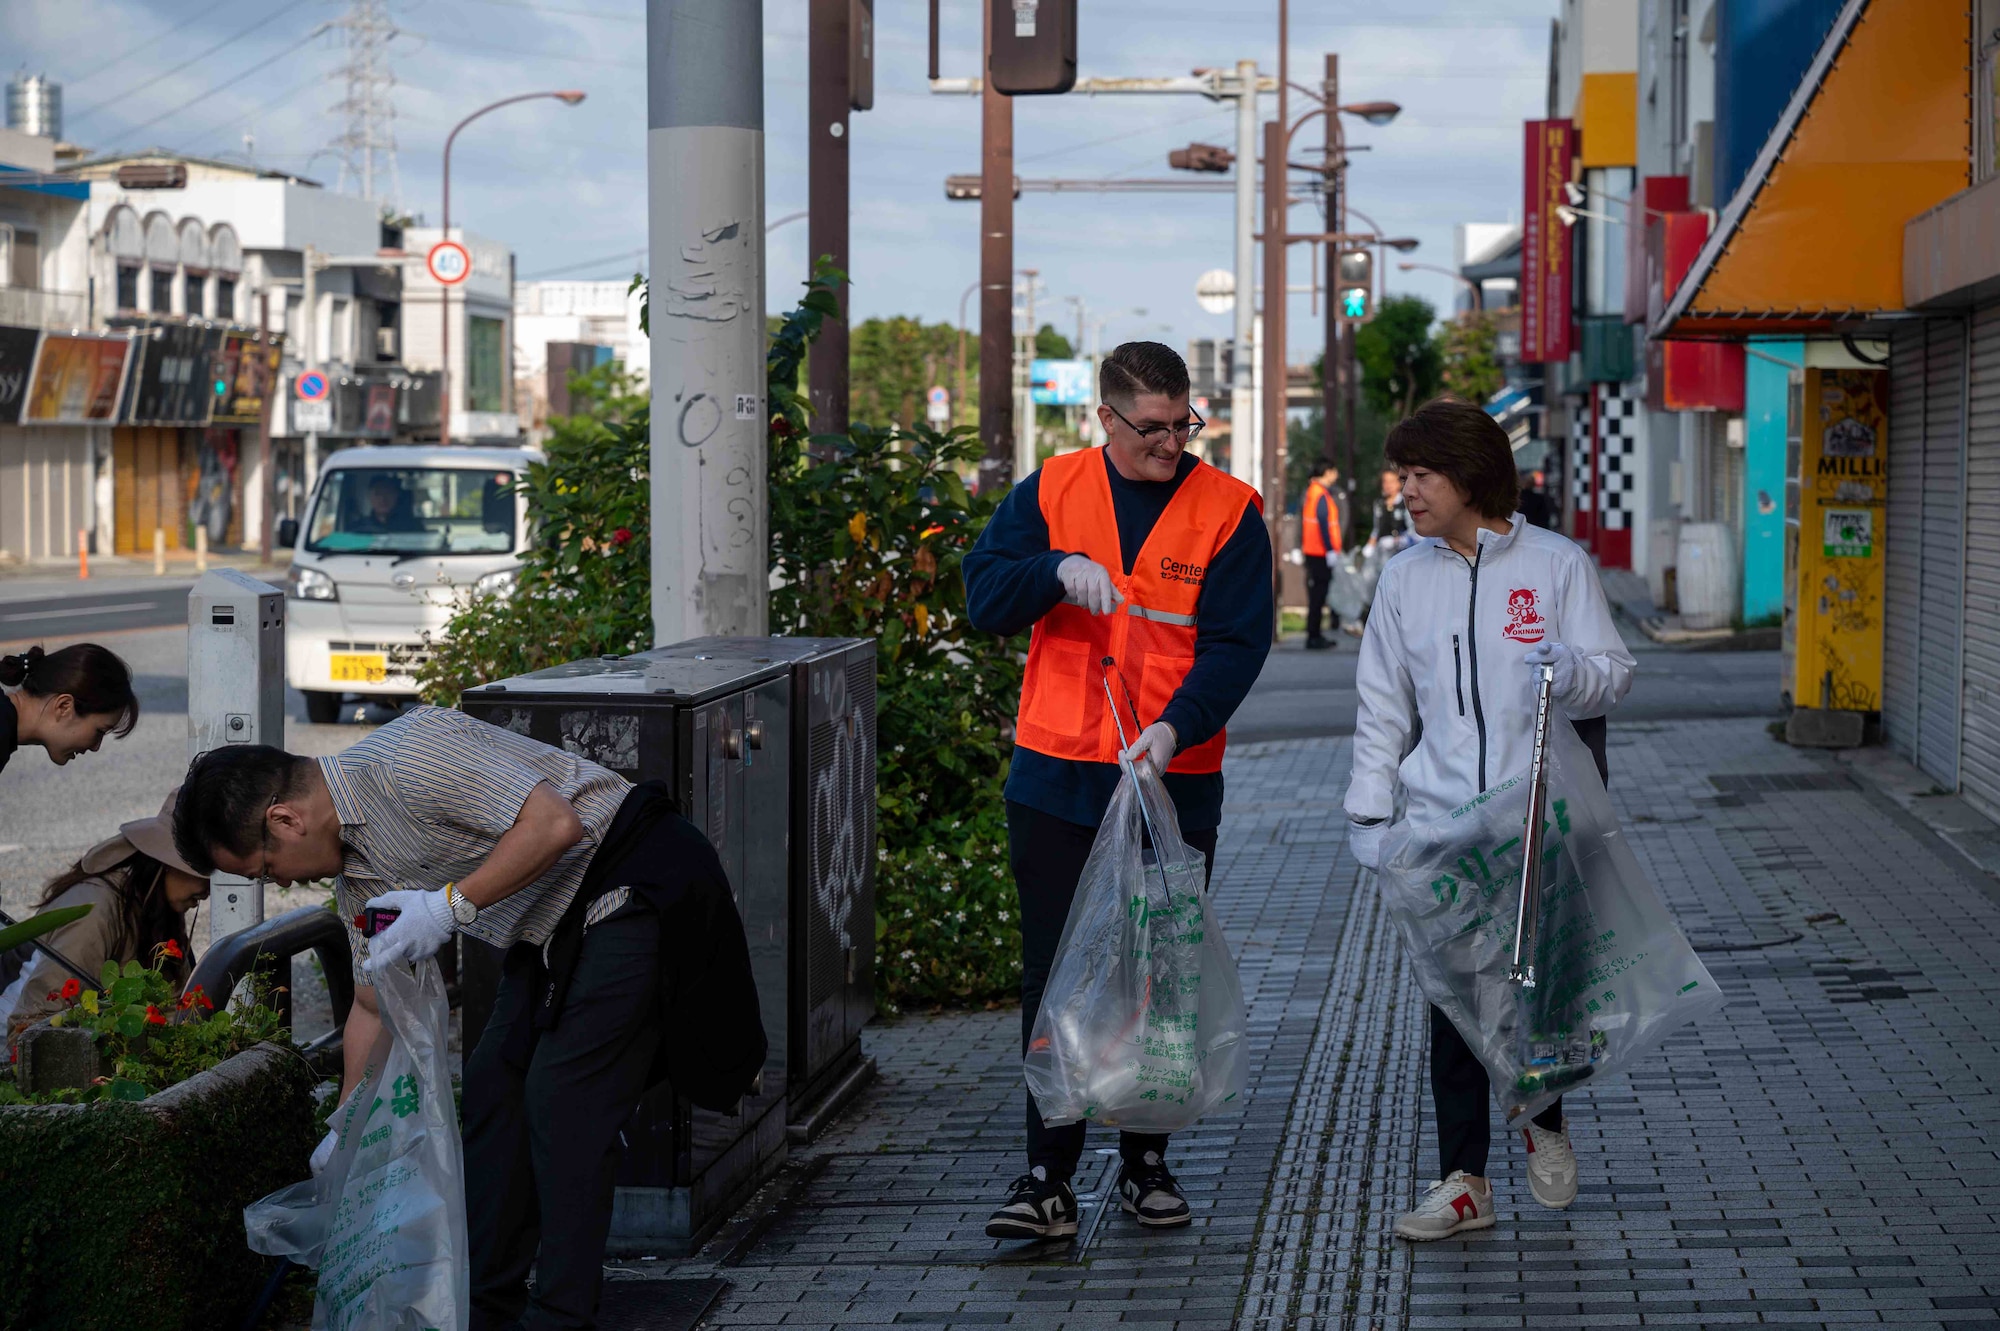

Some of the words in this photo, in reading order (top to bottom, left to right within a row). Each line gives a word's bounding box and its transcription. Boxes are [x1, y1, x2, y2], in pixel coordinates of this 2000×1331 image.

[1817, 458, 1887, 475] MILLI
[1512, 628, 1545, 636] OKINAWA
[391, 1072, 420, 1118] 袋
